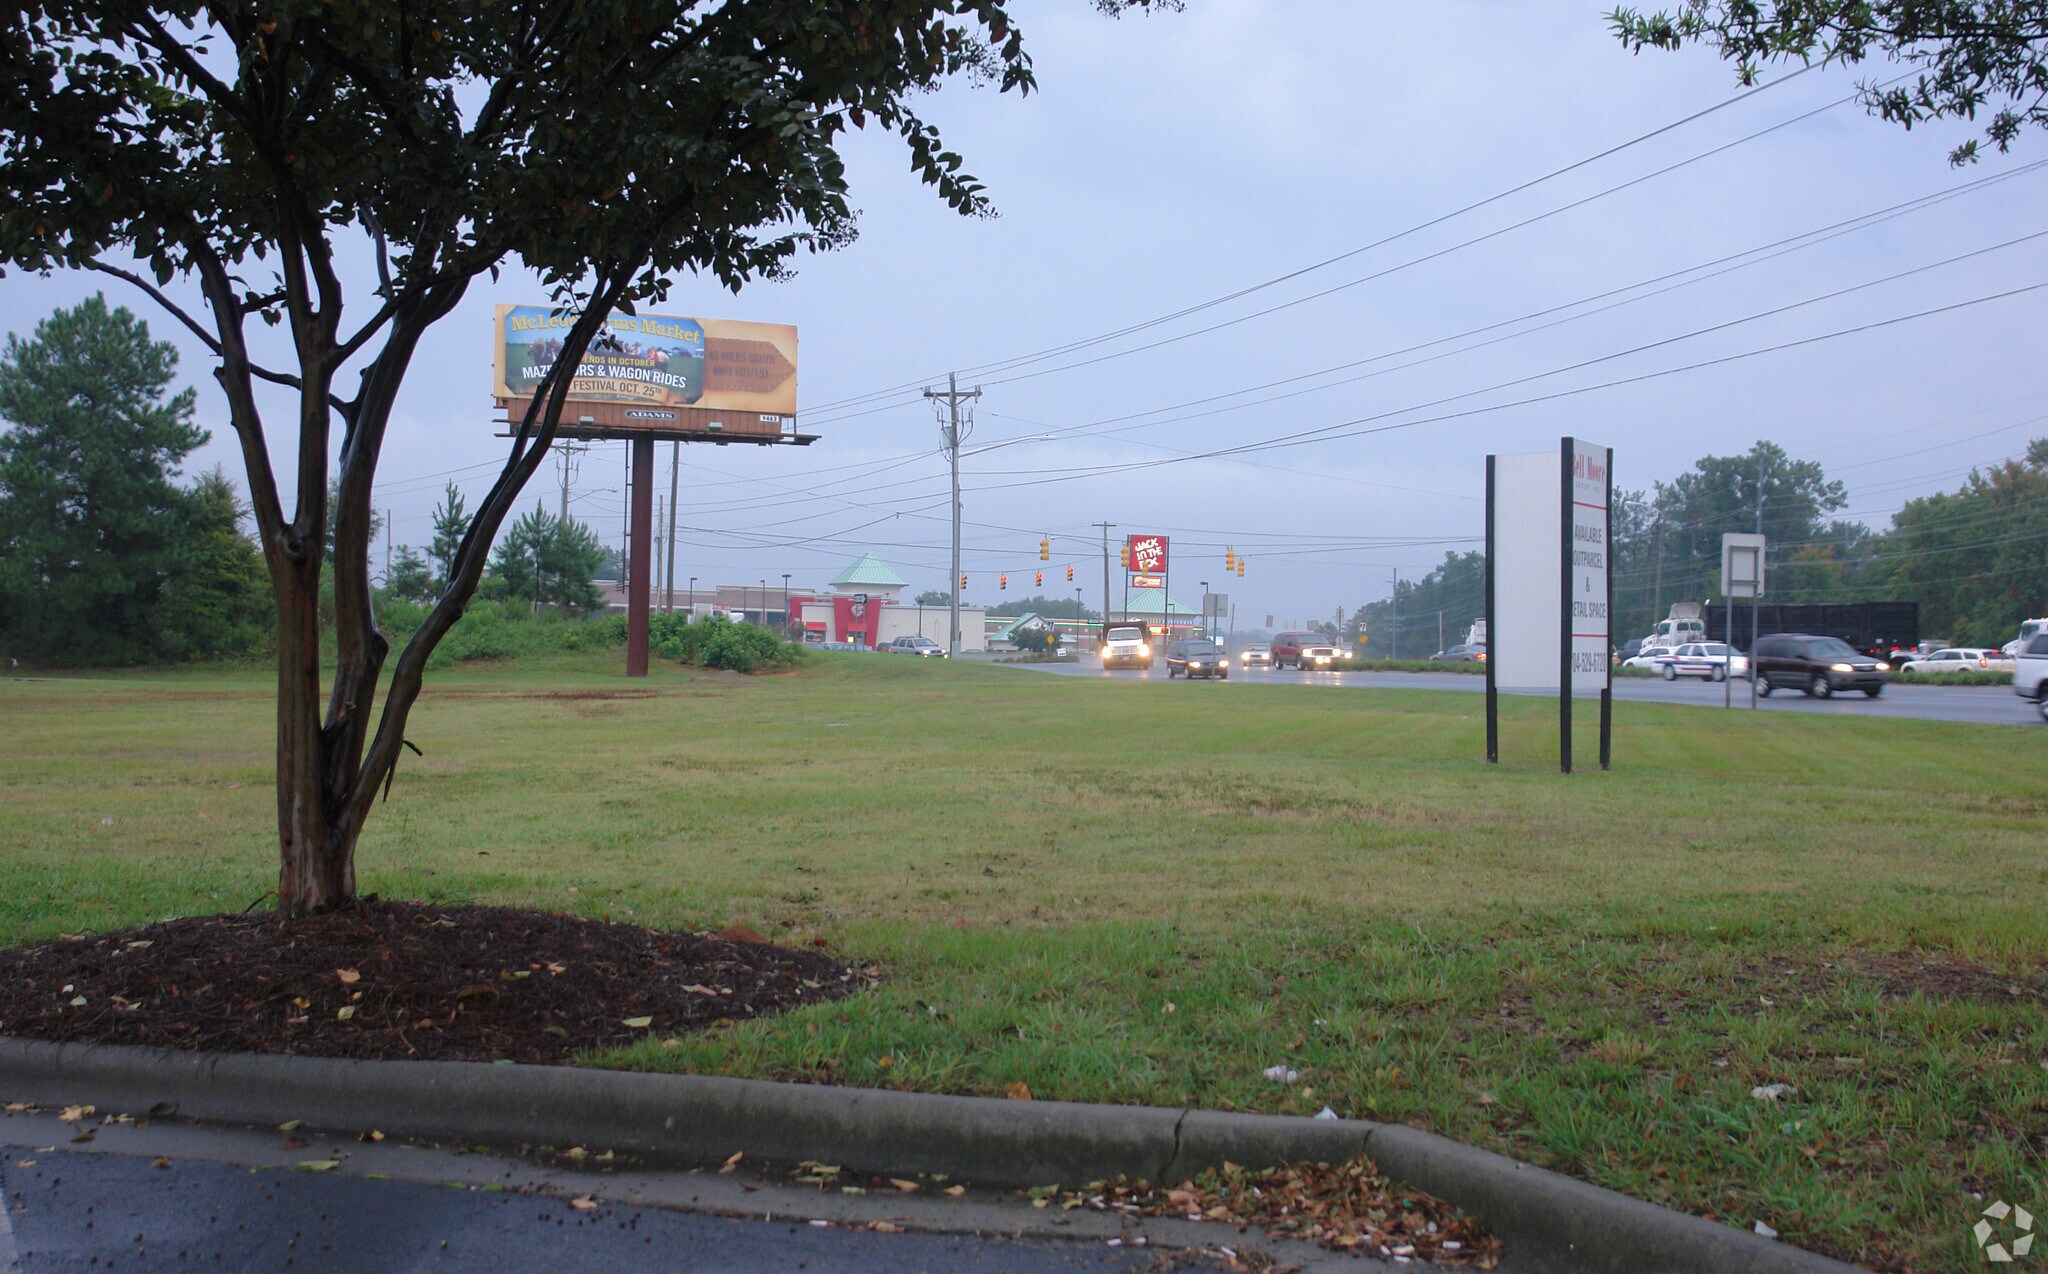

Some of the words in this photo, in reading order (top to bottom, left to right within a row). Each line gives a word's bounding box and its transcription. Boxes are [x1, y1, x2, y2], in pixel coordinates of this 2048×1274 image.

[641, 319, 699, 344] Market
[608, 357, 617, 365] IN
[619, 357, 656, 367] OCTOBER
[708, 351, 719, 360] 45
[721, 351, 746, 362] MILES
[748, 353, 776, 364] SOUTH
[597, 365, 606, 377] &
[608, 366, 650, 381] WAGON
[653, 371, 687, 388] RIDES
[714, 365, 732, 376] HWY
[573, 380, 617, 391] FESTIVAL
[619, 382, 640, 395] OCT.
[630, 411, 673, 419] ADAMS
[1575, 524, 1602, 543] AVAILABLE
[1135, 538, 1159, 551] JACK
[1136, 550, 1147, 561] IN
[1146, 546, 1163, 557] THE
[1585, 576, 1590, 592] &
[1573, 601, 1588, 617] ETAIL
[1589, 601, 1606, 618] SPACE
